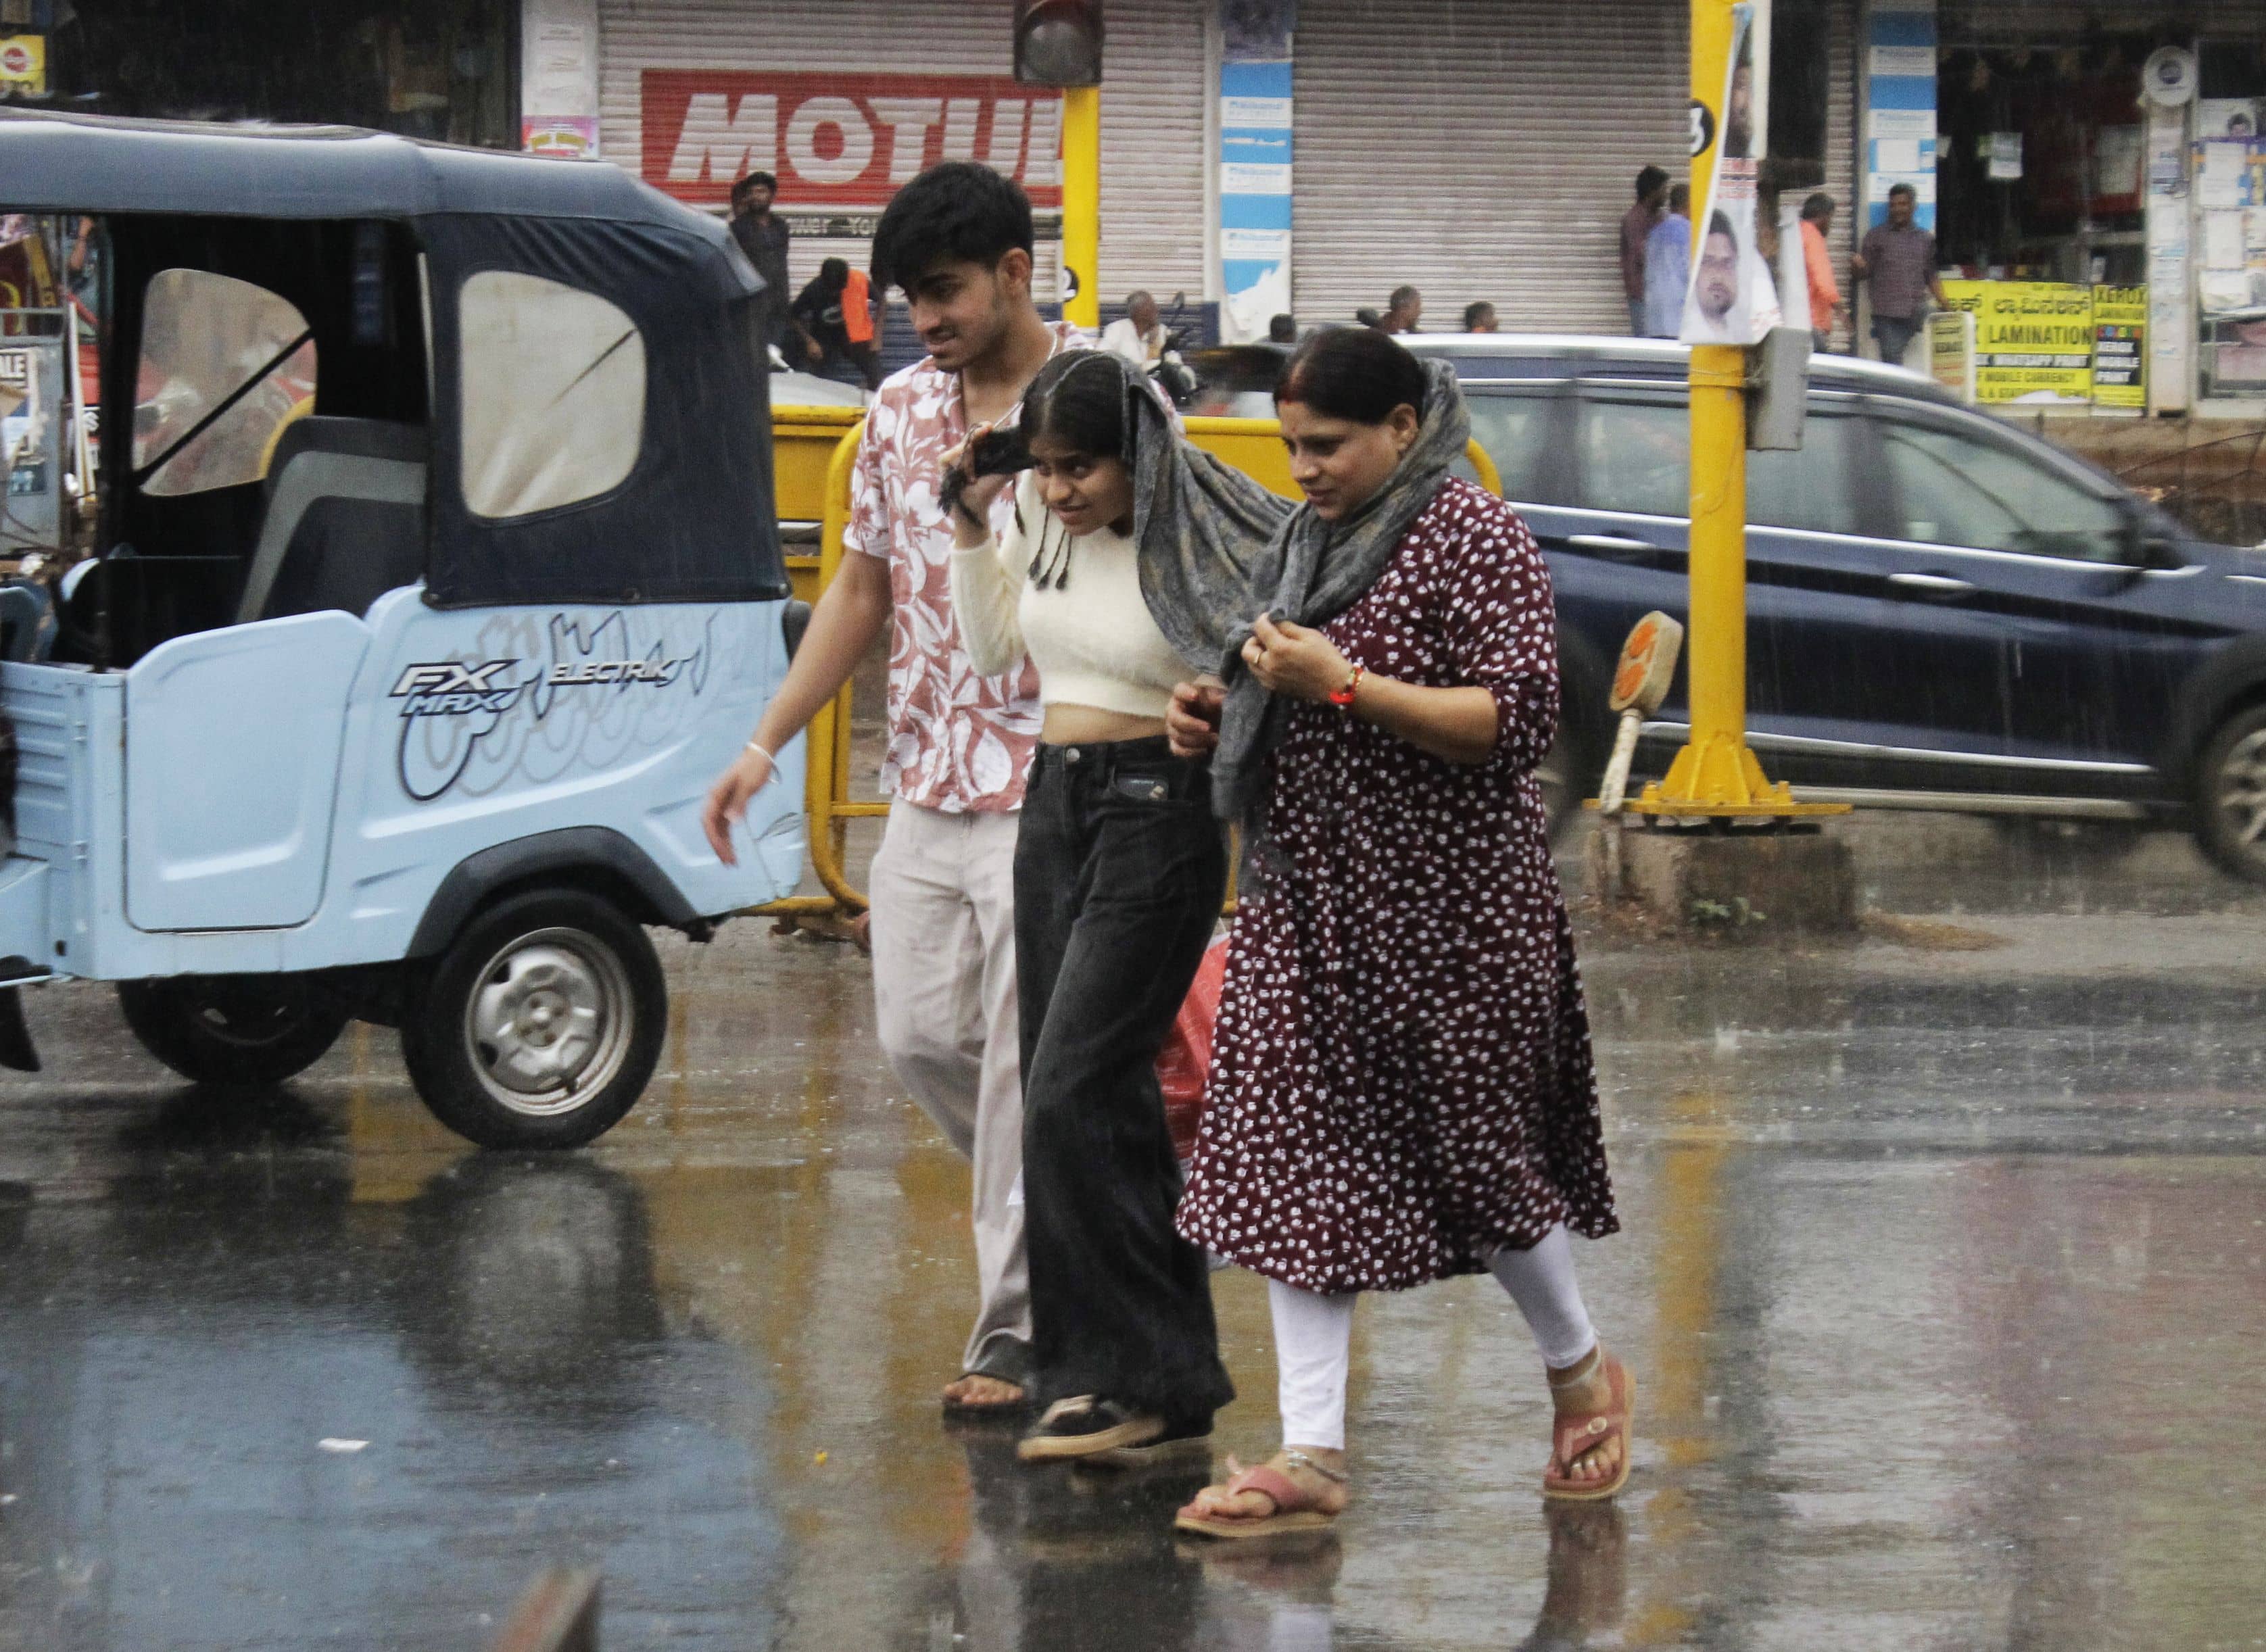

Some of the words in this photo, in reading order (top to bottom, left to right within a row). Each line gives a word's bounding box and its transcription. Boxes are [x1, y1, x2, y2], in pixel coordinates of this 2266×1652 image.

[1990, 326, 2091, 343] LAMINATION
[389, 658, 522, 697] FX
[399, 687, 522, 716] MAX
